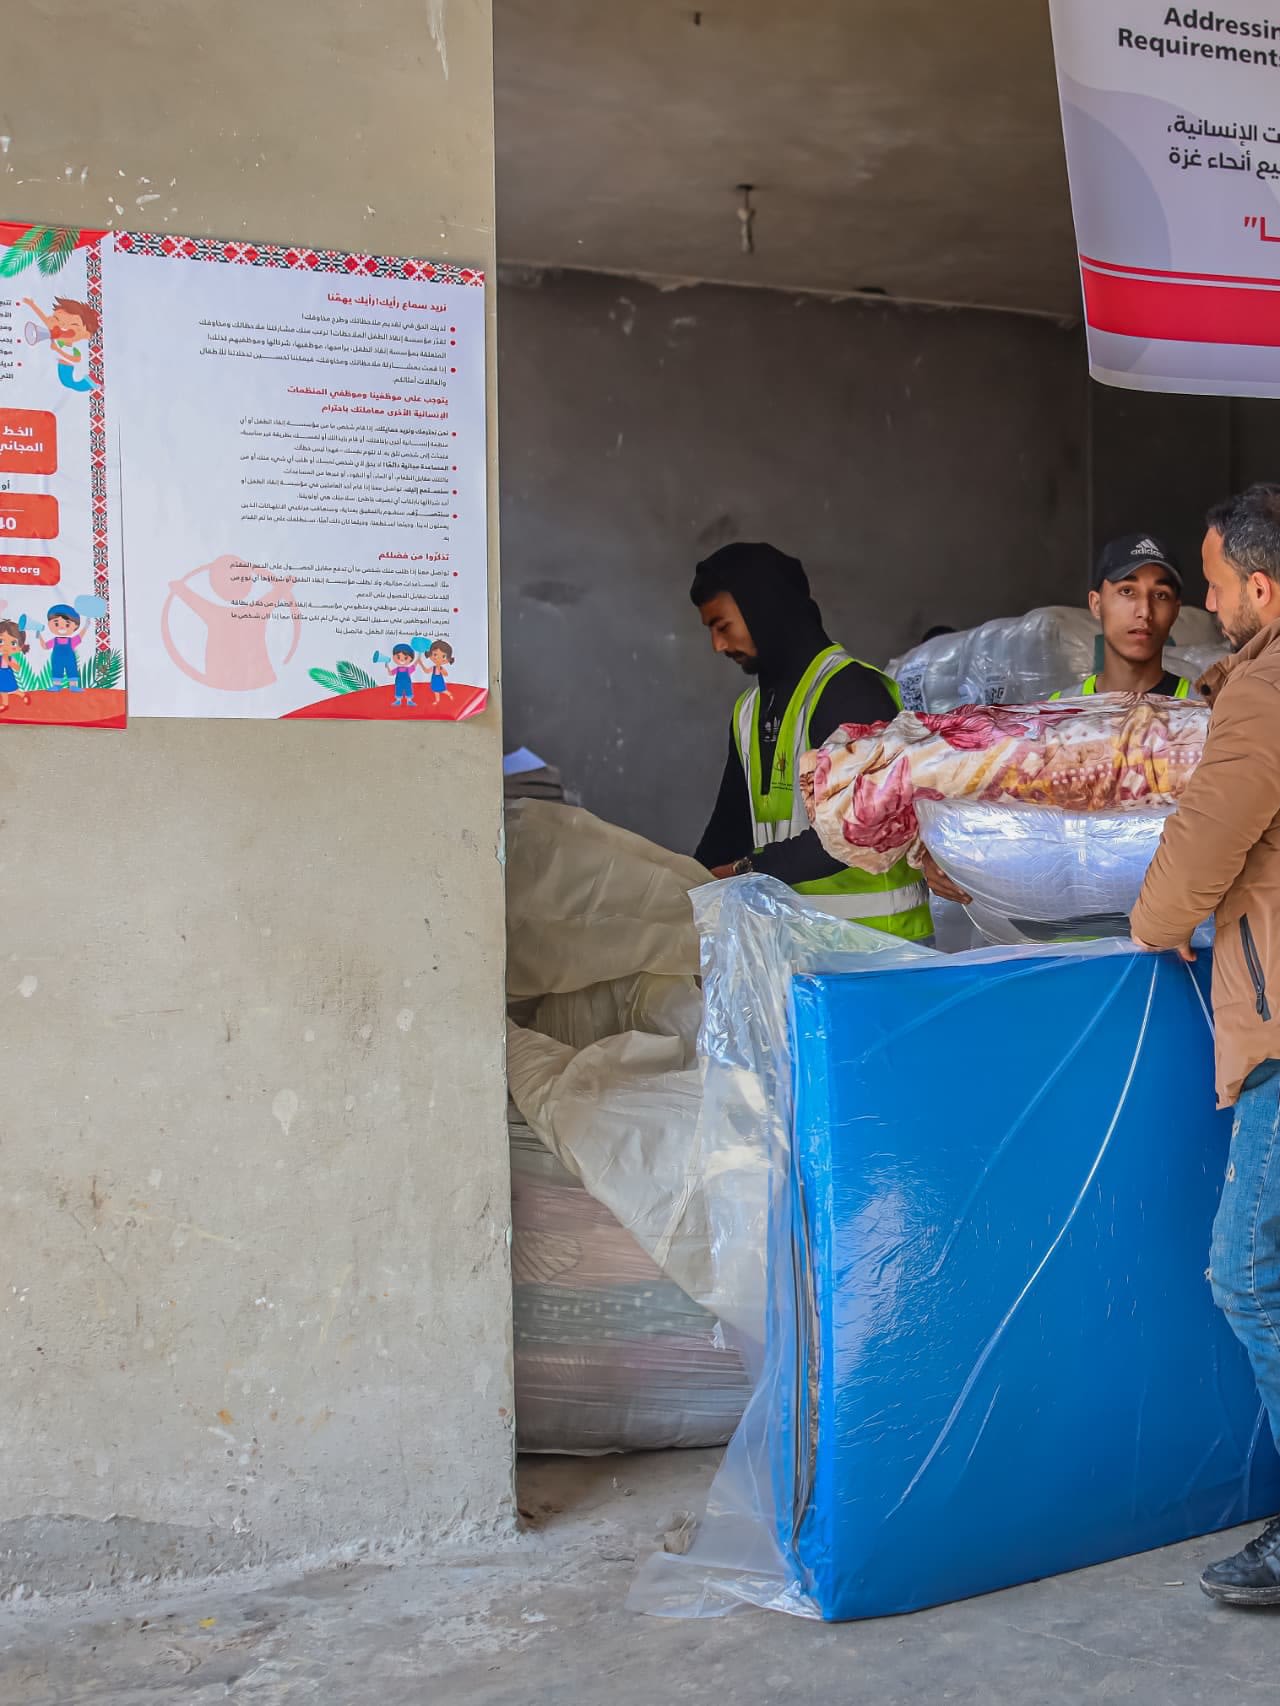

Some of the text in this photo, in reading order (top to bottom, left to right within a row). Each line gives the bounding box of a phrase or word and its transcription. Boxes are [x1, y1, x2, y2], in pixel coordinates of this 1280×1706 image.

[1167, 114, 1257, 147] الإنسانية،
[1168, 144, 1202, 169] غزة
[1208, 150, 1251, 171] أنحاء
[287, 386, 448, 405] يتوجب على موظفينا وموظفي المنظمات
[321, 403, 349, 413] باحترام
[387, 409, 411, 417] الأخرى
[414, 411, 448, 420] الإنسانية
[2, 425, 32, 437] الخط
[1, 480, 10, 491] أو
[378, 552, 408, 560] فضلكم
[1130, 547, 1165, 559] adidas
